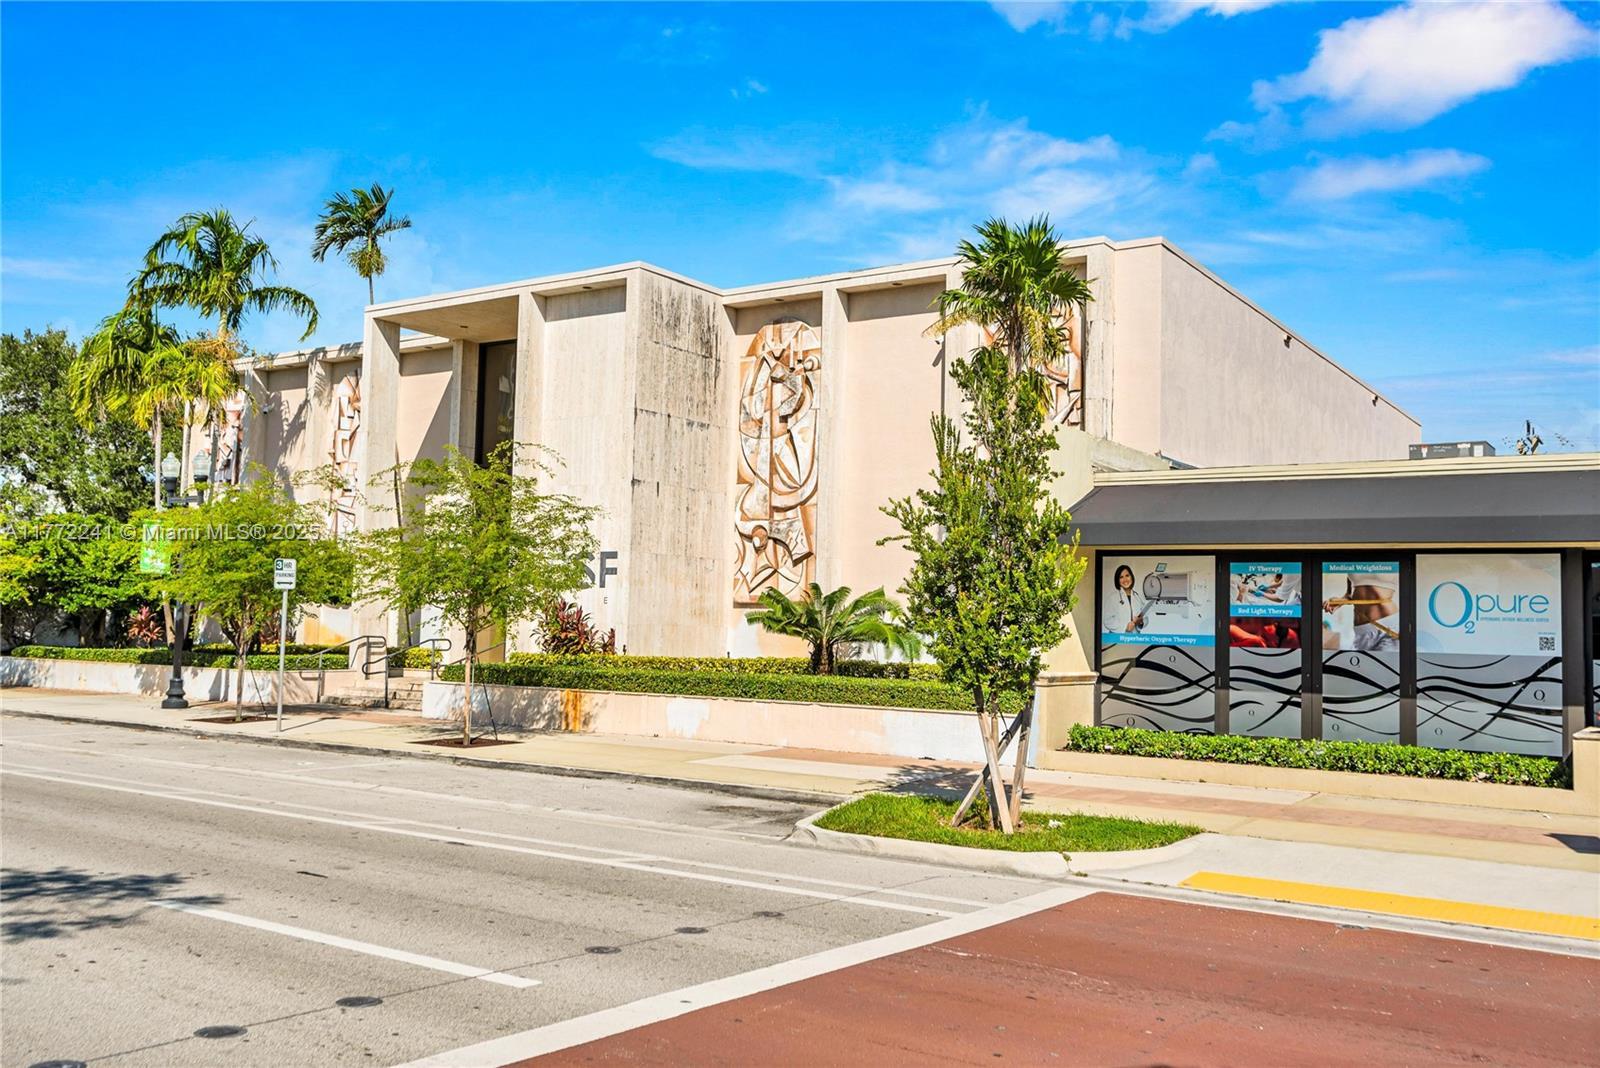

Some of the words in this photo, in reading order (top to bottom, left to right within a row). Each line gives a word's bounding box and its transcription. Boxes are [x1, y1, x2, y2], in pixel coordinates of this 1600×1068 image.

[276, 560, 283, 570] 3
[284, 561, 293, 569] HR
[1257, 565, 1283, 573] Therapy
[1250, 607, 1267, 616] Light
[1268, 608, 1294, 616] Therapy
[1151, 636, 1172, 644] Oxygen
[1173, 636, 1198, 645] Therapy
